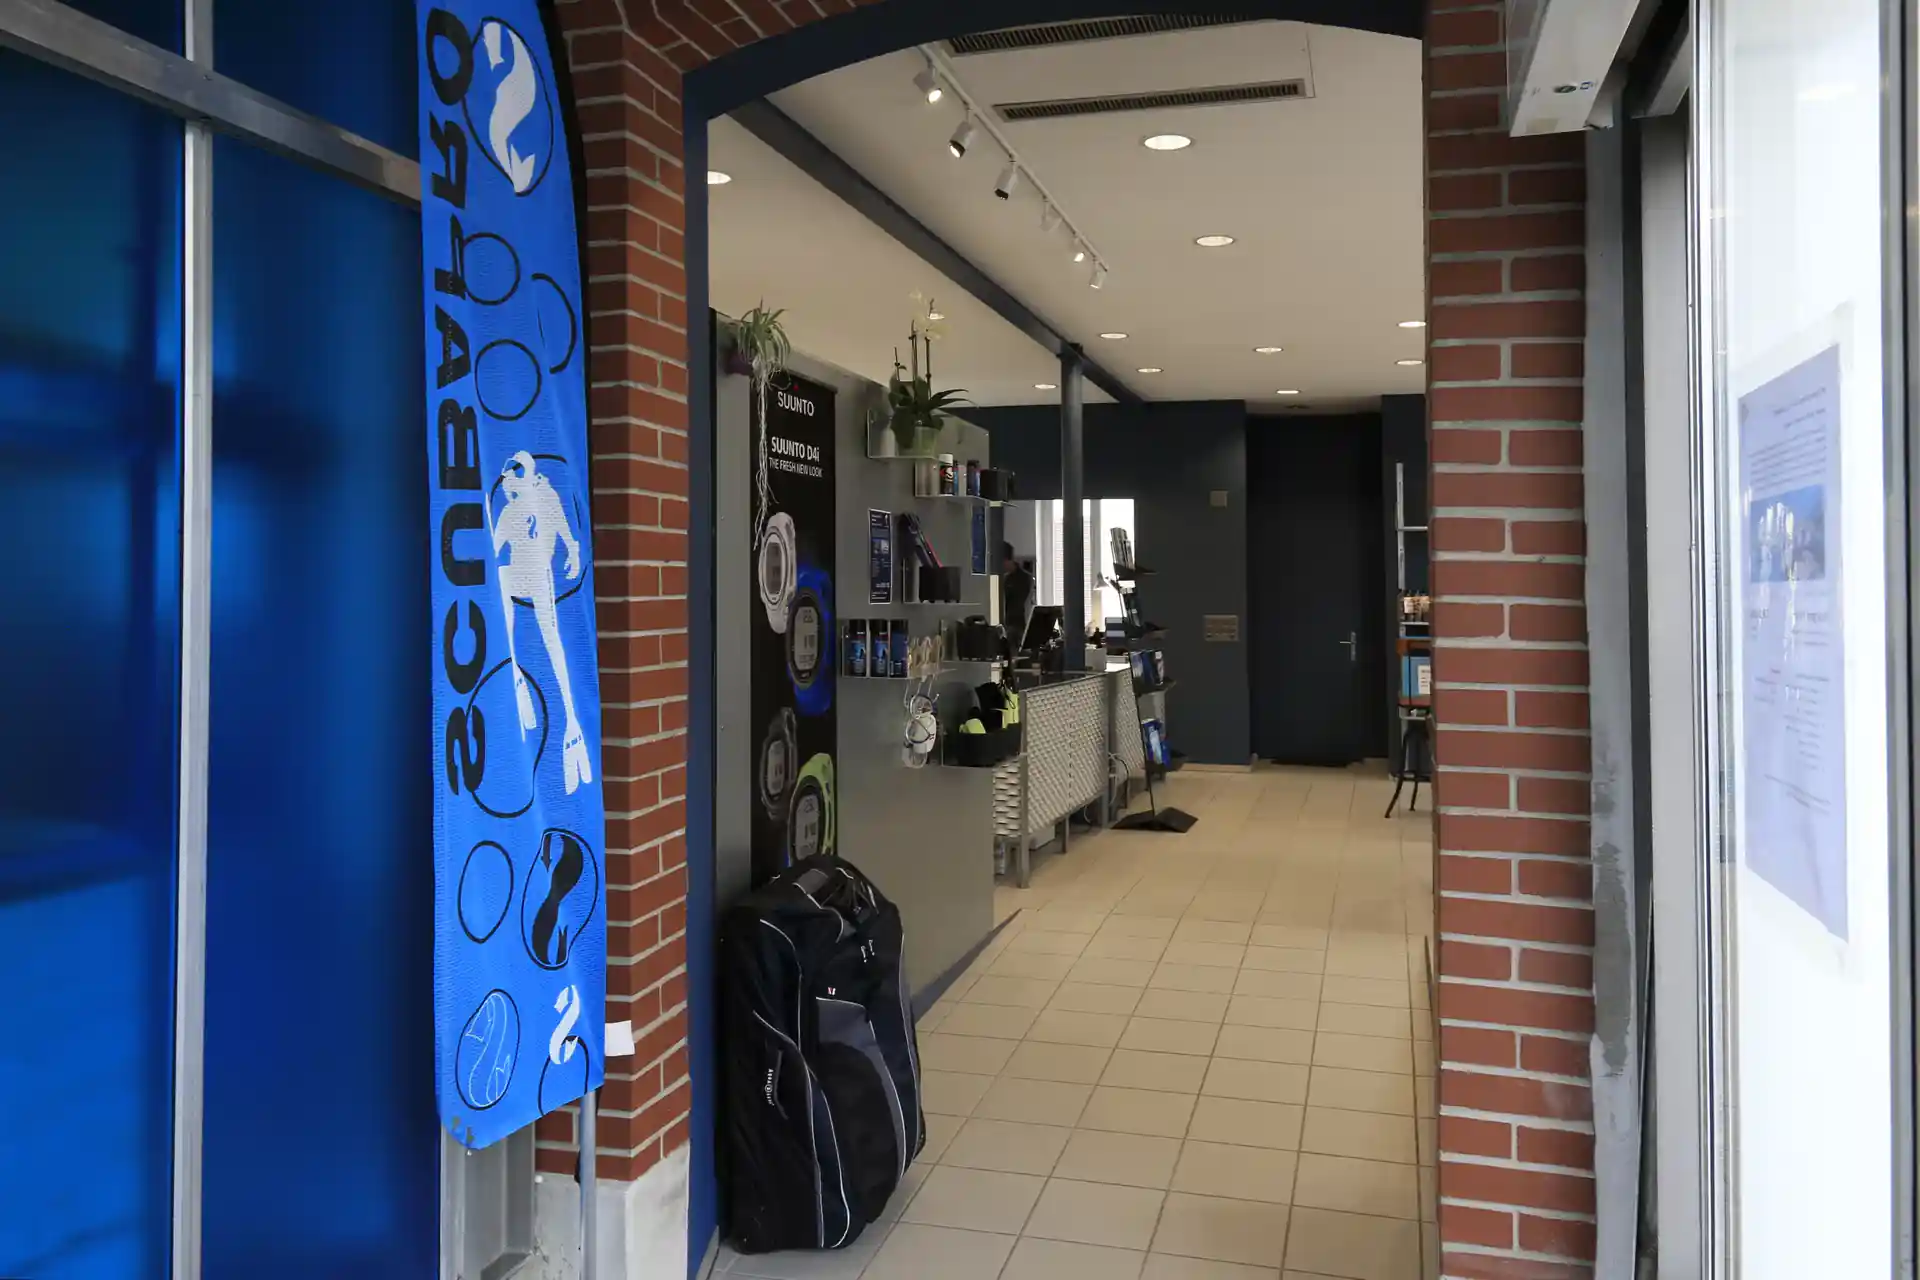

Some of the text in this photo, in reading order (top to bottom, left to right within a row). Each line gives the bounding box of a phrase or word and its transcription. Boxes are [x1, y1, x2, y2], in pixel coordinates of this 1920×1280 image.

[777, 391, 815, 417] SUUNTO
[771, 436, 820, 463] SUUNTO D4i
[769, 457, 823, 478] THE FRESH NEW LOOK
